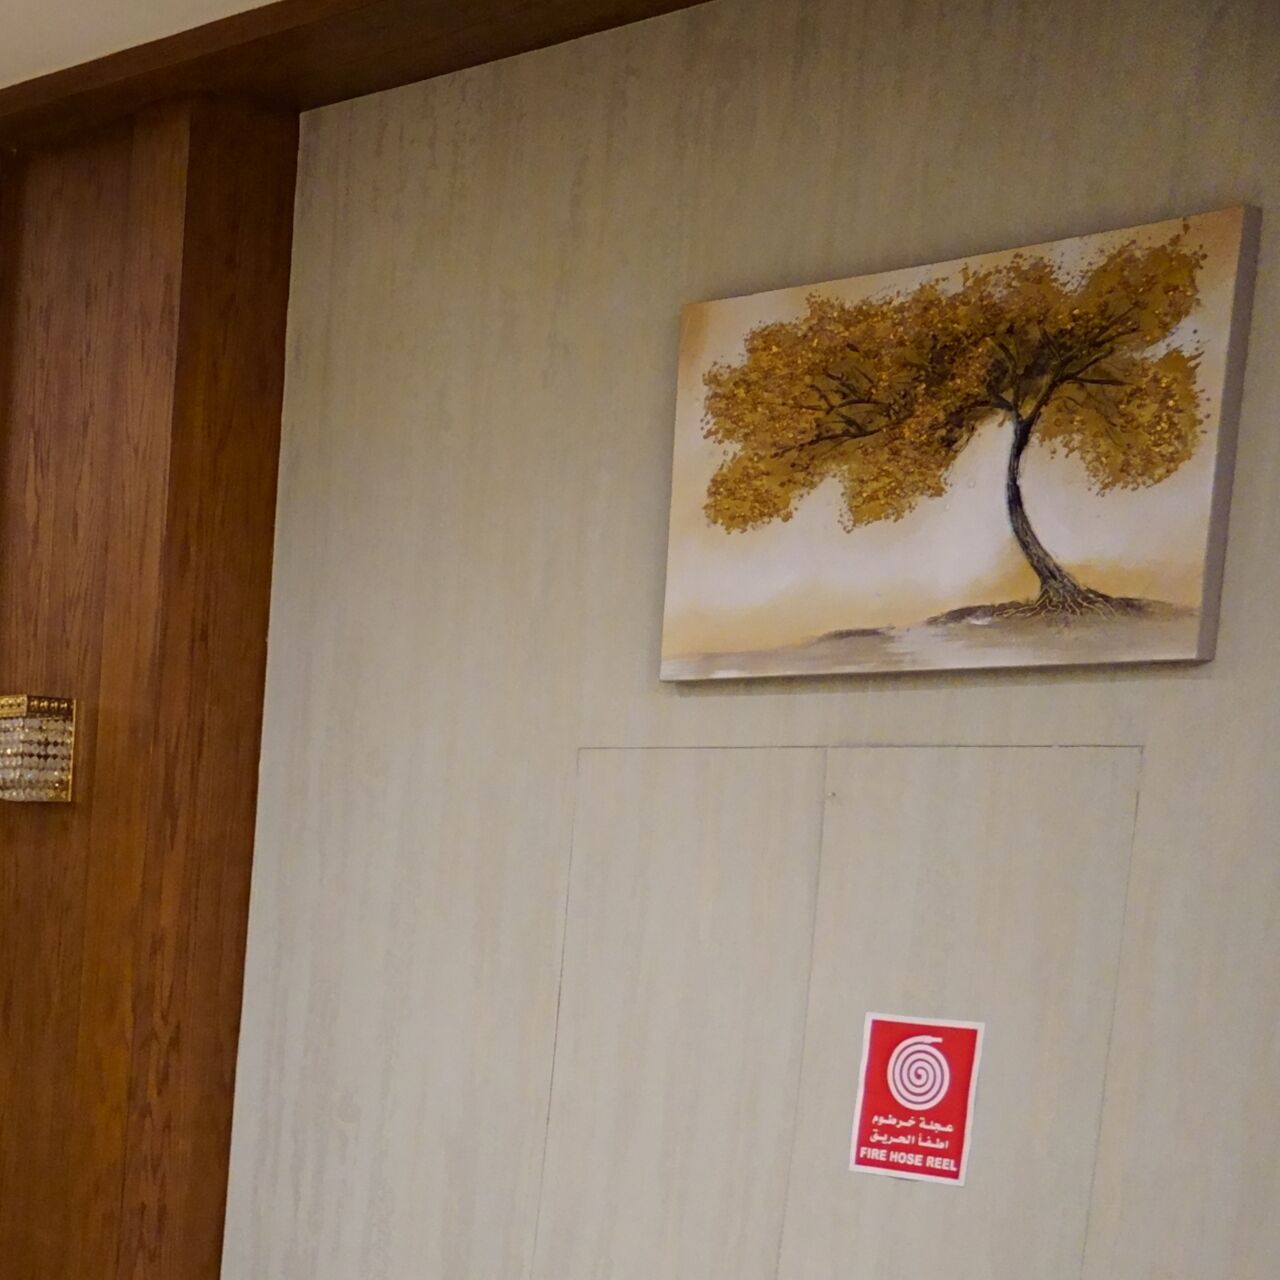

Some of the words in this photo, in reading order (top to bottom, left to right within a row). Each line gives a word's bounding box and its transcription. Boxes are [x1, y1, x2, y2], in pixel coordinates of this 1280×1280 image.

[869, 1128, 915, 1145] الحريق
[859, 1147, 888, 1161] FIRE
[889, 1150, 924, 1166] HOSE
[926, 1155, 958, 1172] REEL
